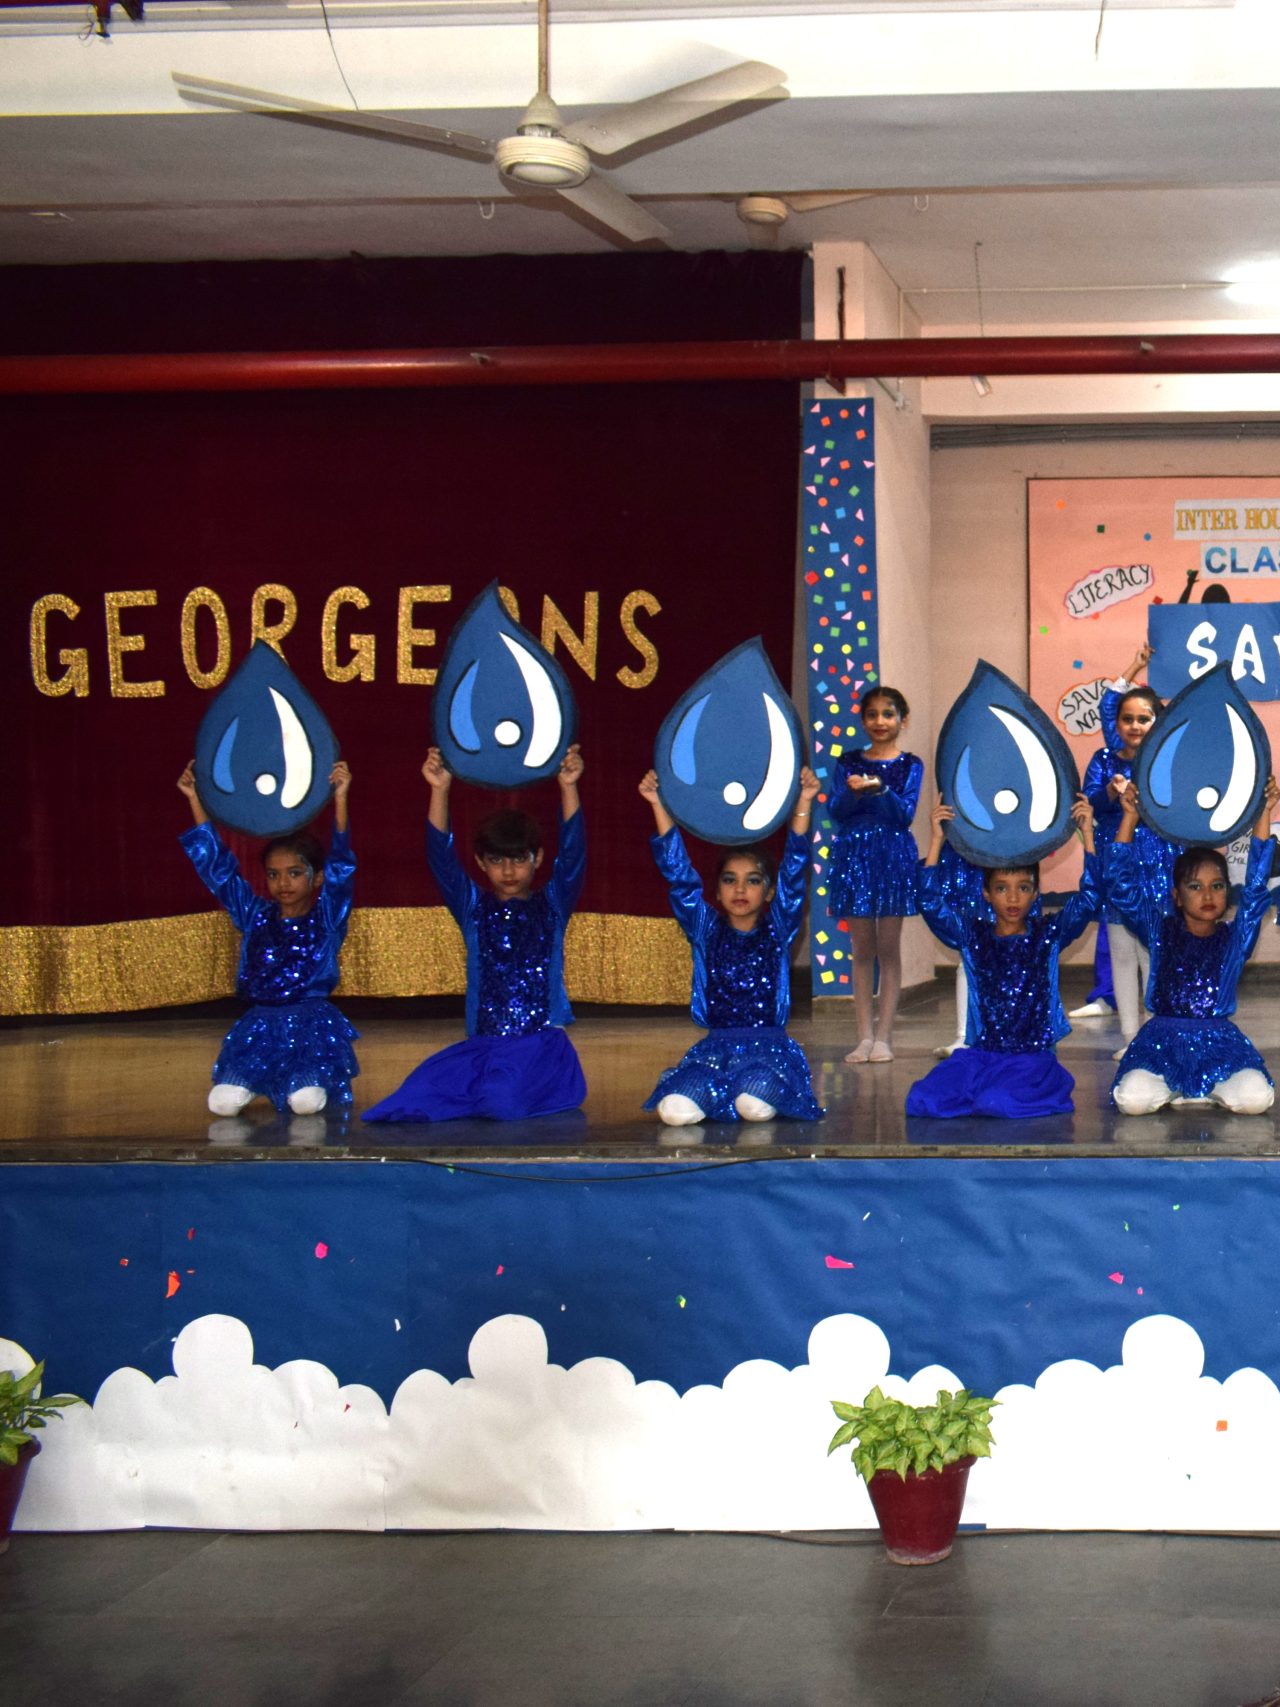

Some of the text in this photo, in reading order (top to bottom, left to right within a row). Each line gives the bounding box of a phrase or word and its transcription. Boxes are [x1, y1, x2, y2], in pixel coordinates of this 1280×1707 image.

[1176, 508, 1239, 531] INTER
[1068, 564, 1150, 615] LITERACY
[29, 583, 662, 698] GEORGENS
